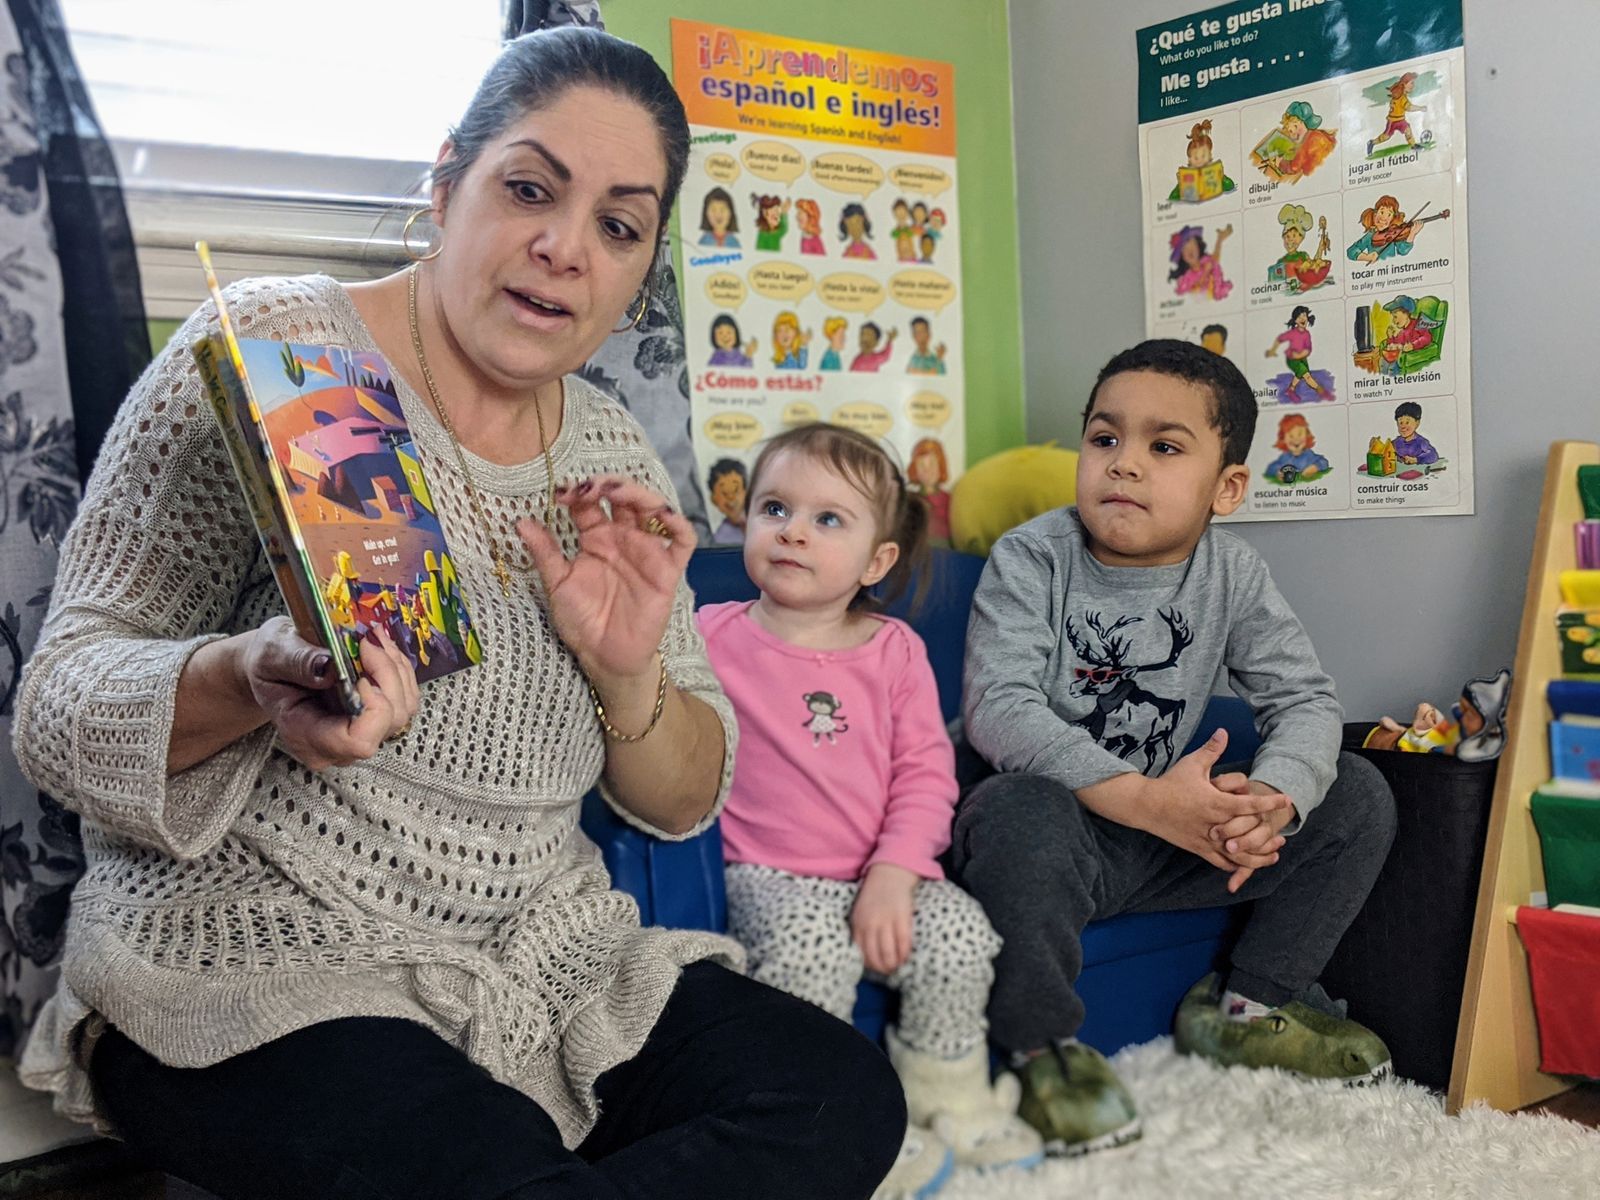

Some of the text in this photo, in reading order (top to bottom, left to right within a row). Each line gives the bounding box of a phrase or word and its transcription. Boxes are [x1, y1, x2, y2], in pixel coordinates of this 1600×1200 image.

[1150, 2, 1283, 56] ¿Qué te gusta
[1159, 30, 1259, 66] What do you like to do?
[1160, 73, 1191, 93] Me
[1196, 57, 1251, 88] gusta
[702, 77, 940, 127] español e inglés!
[738, 113, 766, 127] We're
[768, 116, 808, 134] learning
[810, 122, 847, 137] Spanish
[848, 127, 865, 139] and
[687, 133, 737, 145] reetings
[1348, 151, 1419, 176] jugar al fútbol
[1357, 175, 1371, 184] play
[1372, 171, 1392, 180] soccer
[1248, 181, 1280, 195] dibujar
[1256, 195, 1272, 203] draw
[690, 252, 743, 267] Goodbyes
[1351, 269, 1374, 280] tocar
[1391, 258, 1450, 274] instrumento
[1250, 282, 1281, 295] cocinar
[1351, 275, 1424, 291] to play my instrument
[695, 371, 824, 392] ¿Cómo estás?
[1354, 370, 1441, 388] mirar la televisión
[1252, 387, 1277, 398] bailar
[1362, 389, 1383, 398] watch
[1384, 388, 1393, 396] TV
[1254, 486, 1328, 498] escuchar música
[1357, 482, 1429, 494] construir cosas
[1280, 500, 1287, 508] to
[1366, 496, 1384, 504] make
[1385, 495, 1406, 505] things
